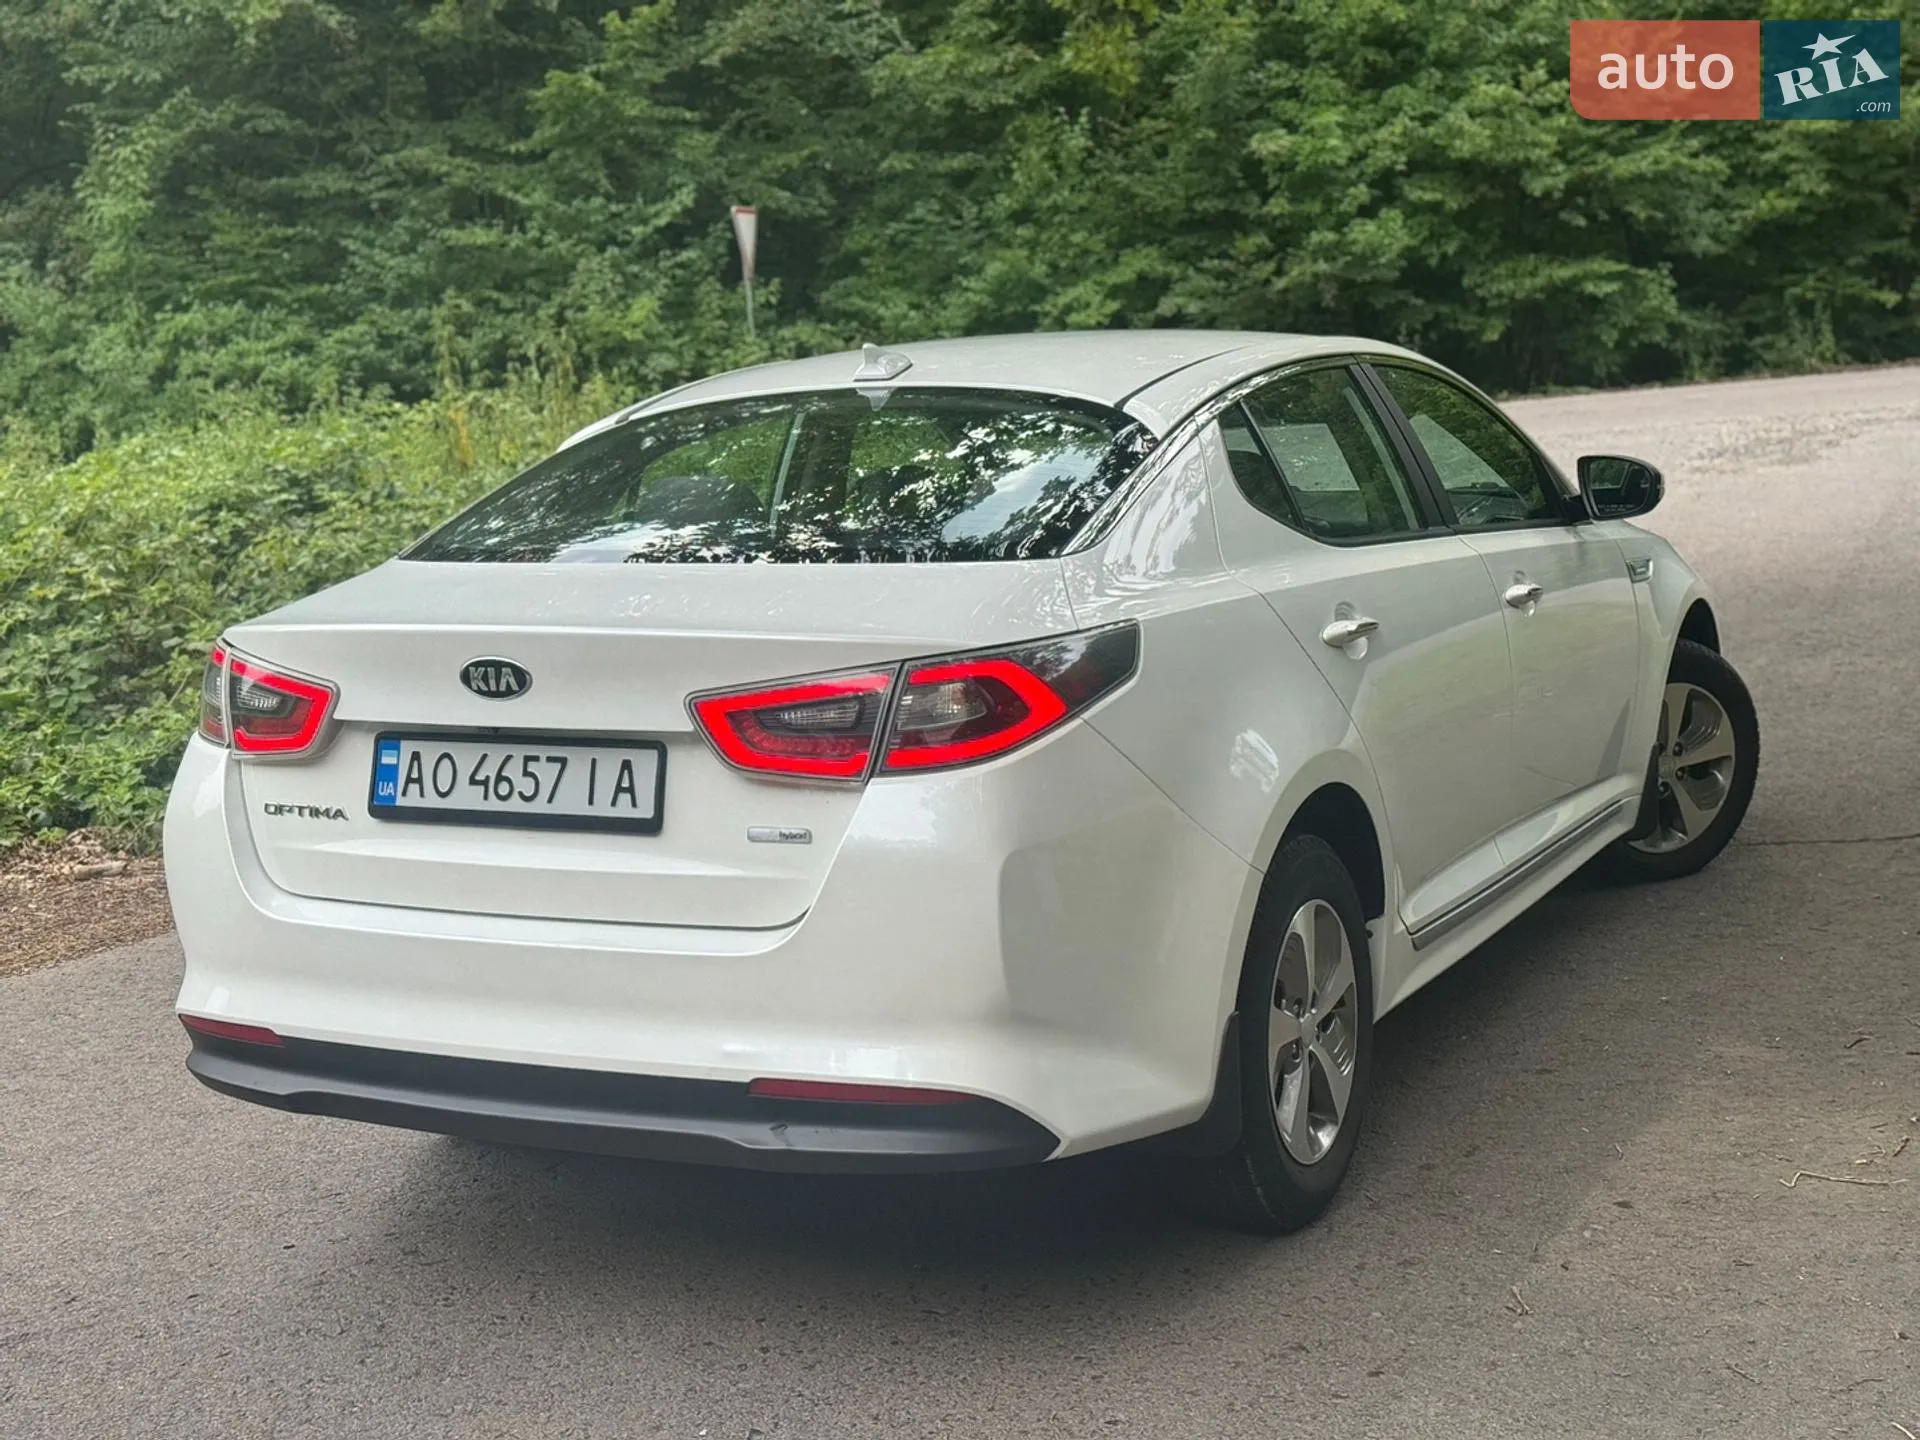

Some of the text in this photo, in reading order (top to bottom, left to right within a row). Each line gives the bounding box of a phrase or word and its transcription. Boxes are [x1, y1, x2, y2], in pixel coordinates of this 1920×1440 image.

[468, 666, 519, 691] KIA
[378, 781, 395, 796] UA
[401, 750, 638, 808] AO 4657 IA
[264, 802, 349, 821] OPTIMA
